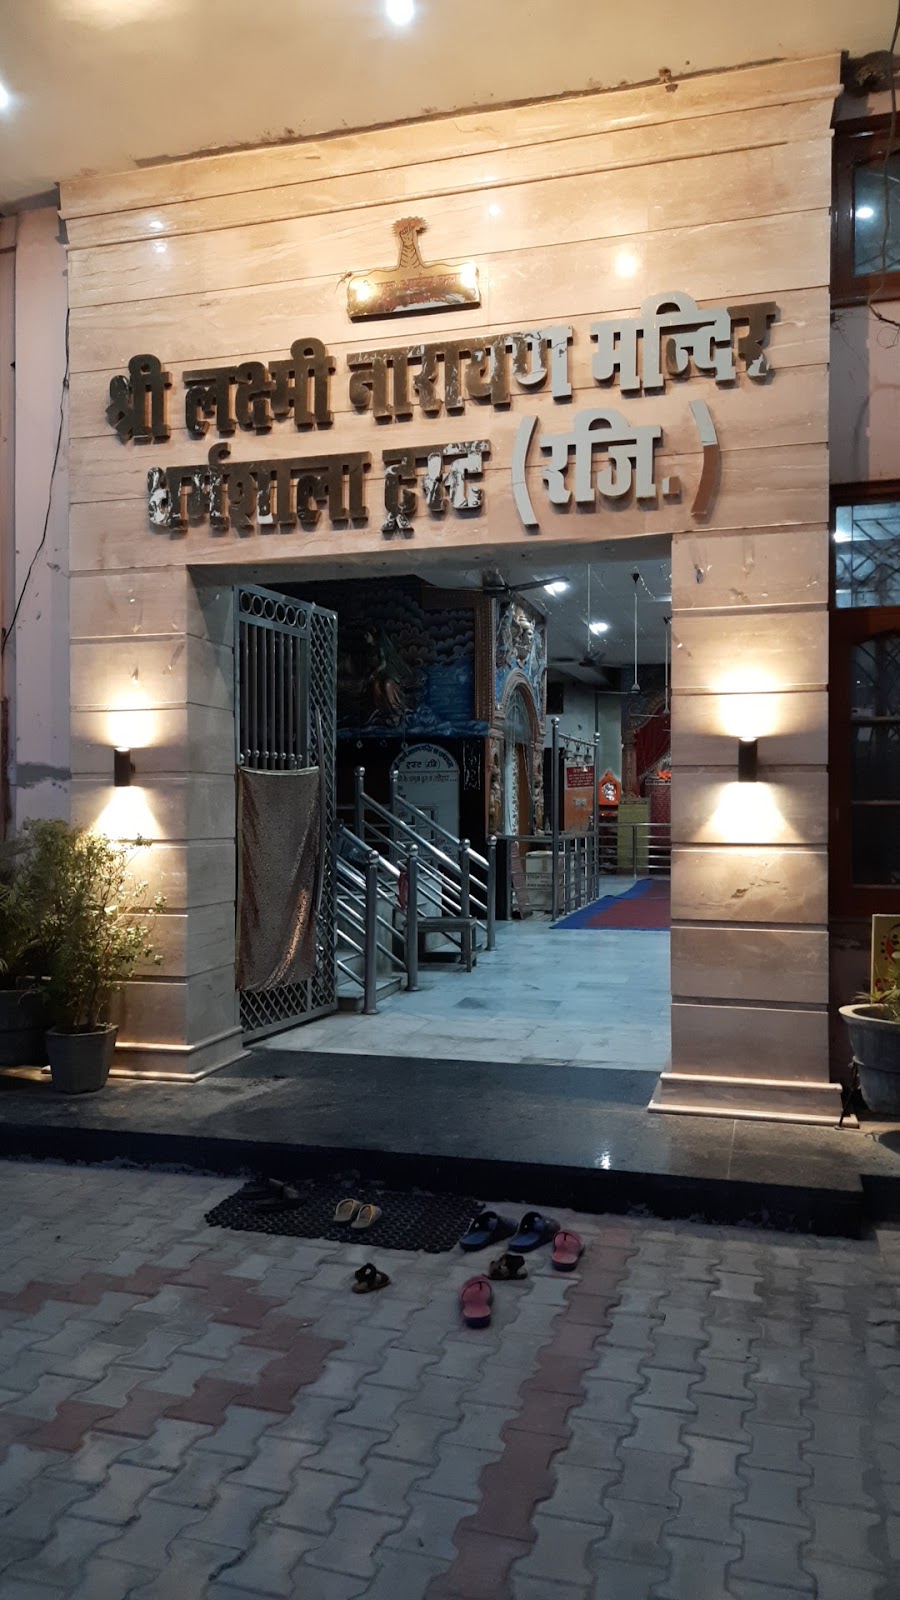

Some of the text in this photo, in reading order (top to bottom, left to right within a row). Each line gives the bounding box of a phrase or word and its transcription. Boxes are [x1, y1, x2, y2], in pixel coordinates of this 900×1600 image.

[105, 291, 776, 443] श्री लक्ष्मी नारायण मन्दिर
[147, 441, 371, 536] धर्मशाला
